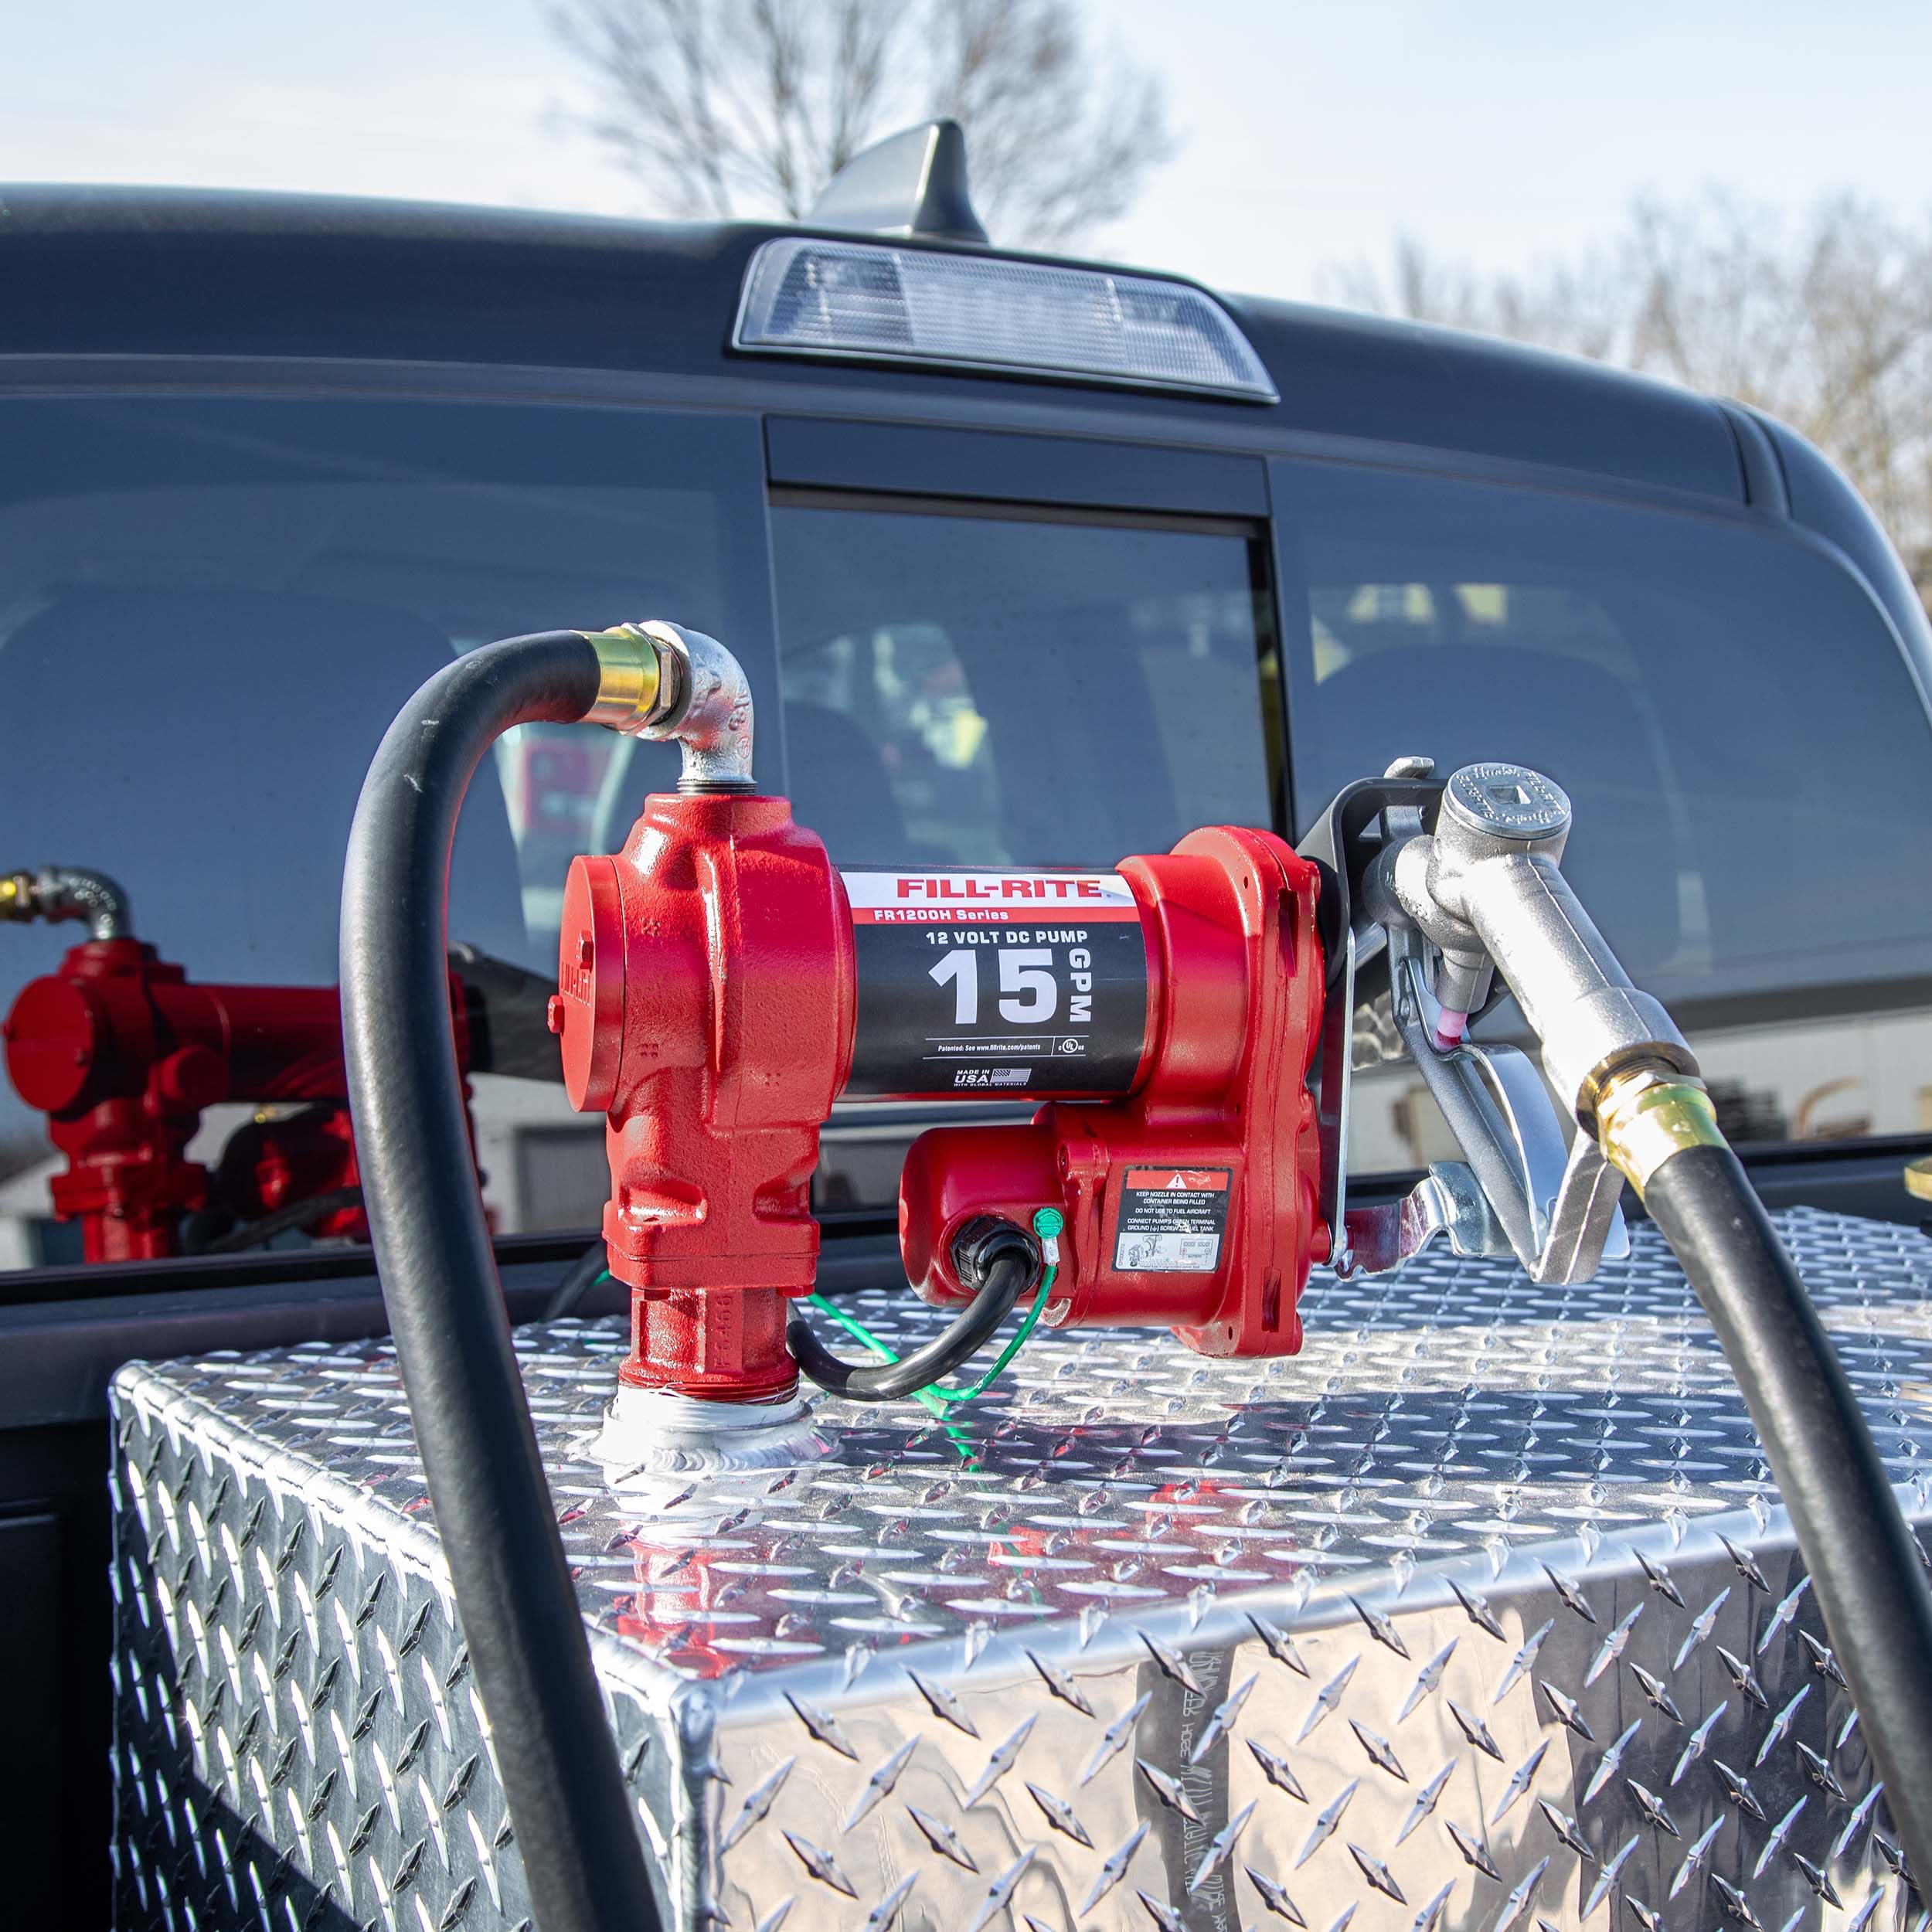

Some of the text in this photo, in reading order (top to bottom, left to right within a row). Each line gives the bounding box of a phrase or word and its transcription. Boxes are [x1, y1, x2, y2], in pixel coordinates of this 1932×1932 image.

[896, 878, 1103, 899] FILL-RITE
[873, 909, 1009, 921] FR1200H Series
[926, 930, 1088, 944] 12 VOLT DC PUMP
[927, 948, 1058, 1026] 15
[1069, 948, 1091, 1023] GPM
[977, 1043, 1041, 1052] www.fillrite.com/patents
[954, 1074, 988, 1083] USA
